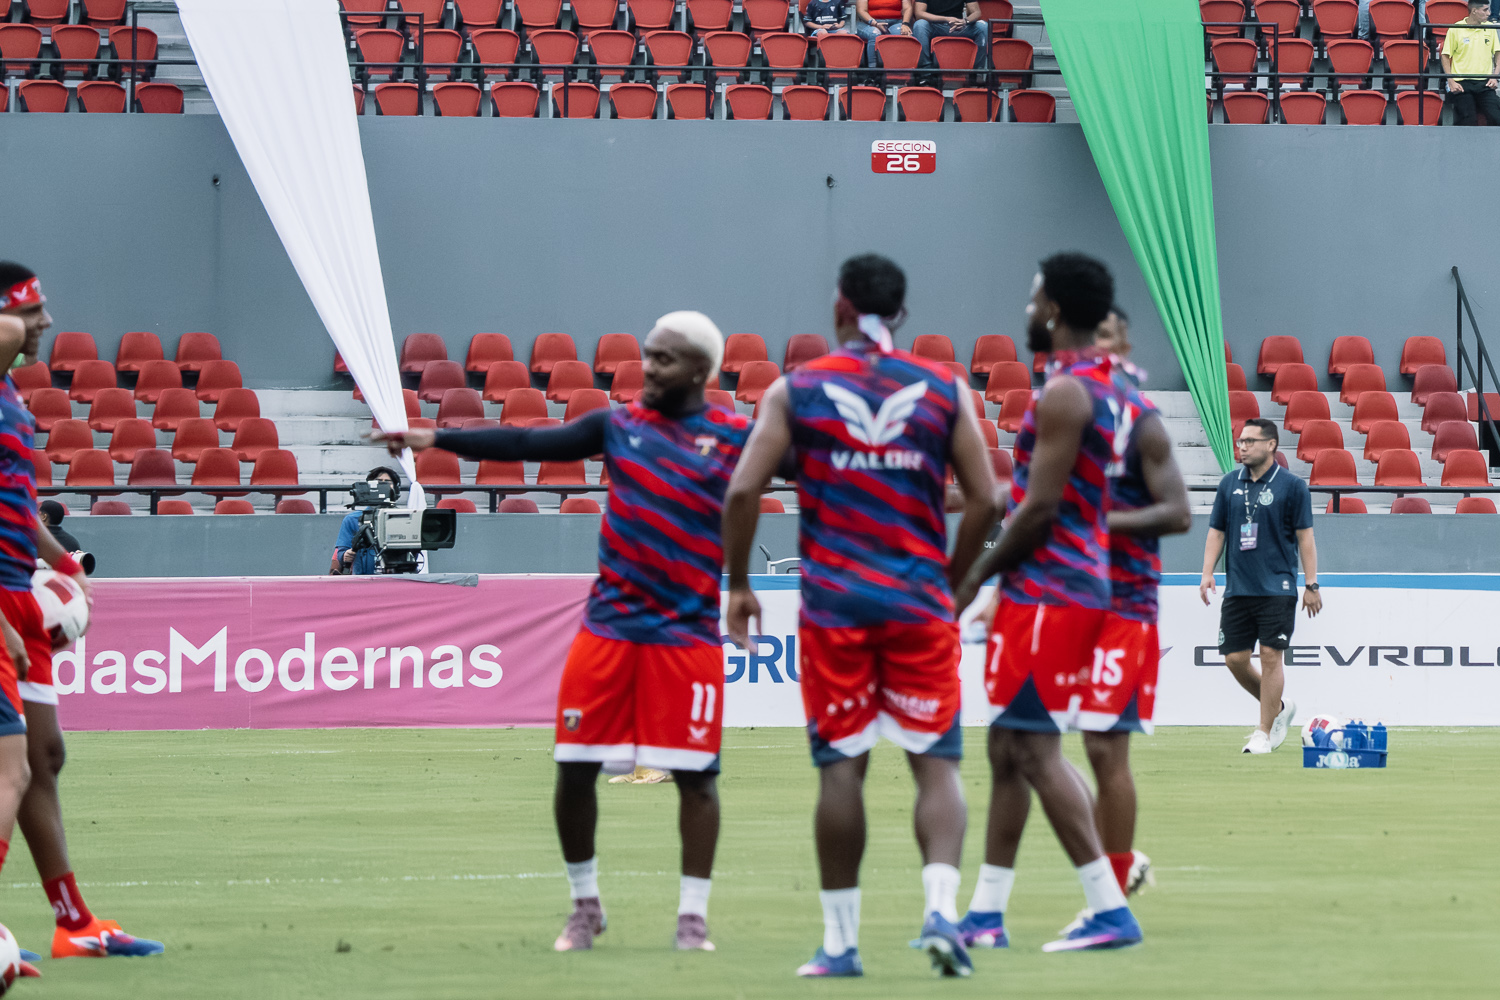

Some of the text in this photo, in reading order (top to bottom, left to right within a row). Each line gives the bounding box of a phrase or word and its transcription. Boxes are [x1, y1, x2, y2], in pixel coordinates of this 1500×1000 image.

[877, 142, 931, 152] SECCION
[886, 154, 920, 171] 26
[830, 450, 924, 470] VALOR
[1091, 646, 1126, 687] 15
[690, 681, 716, 723] 11
